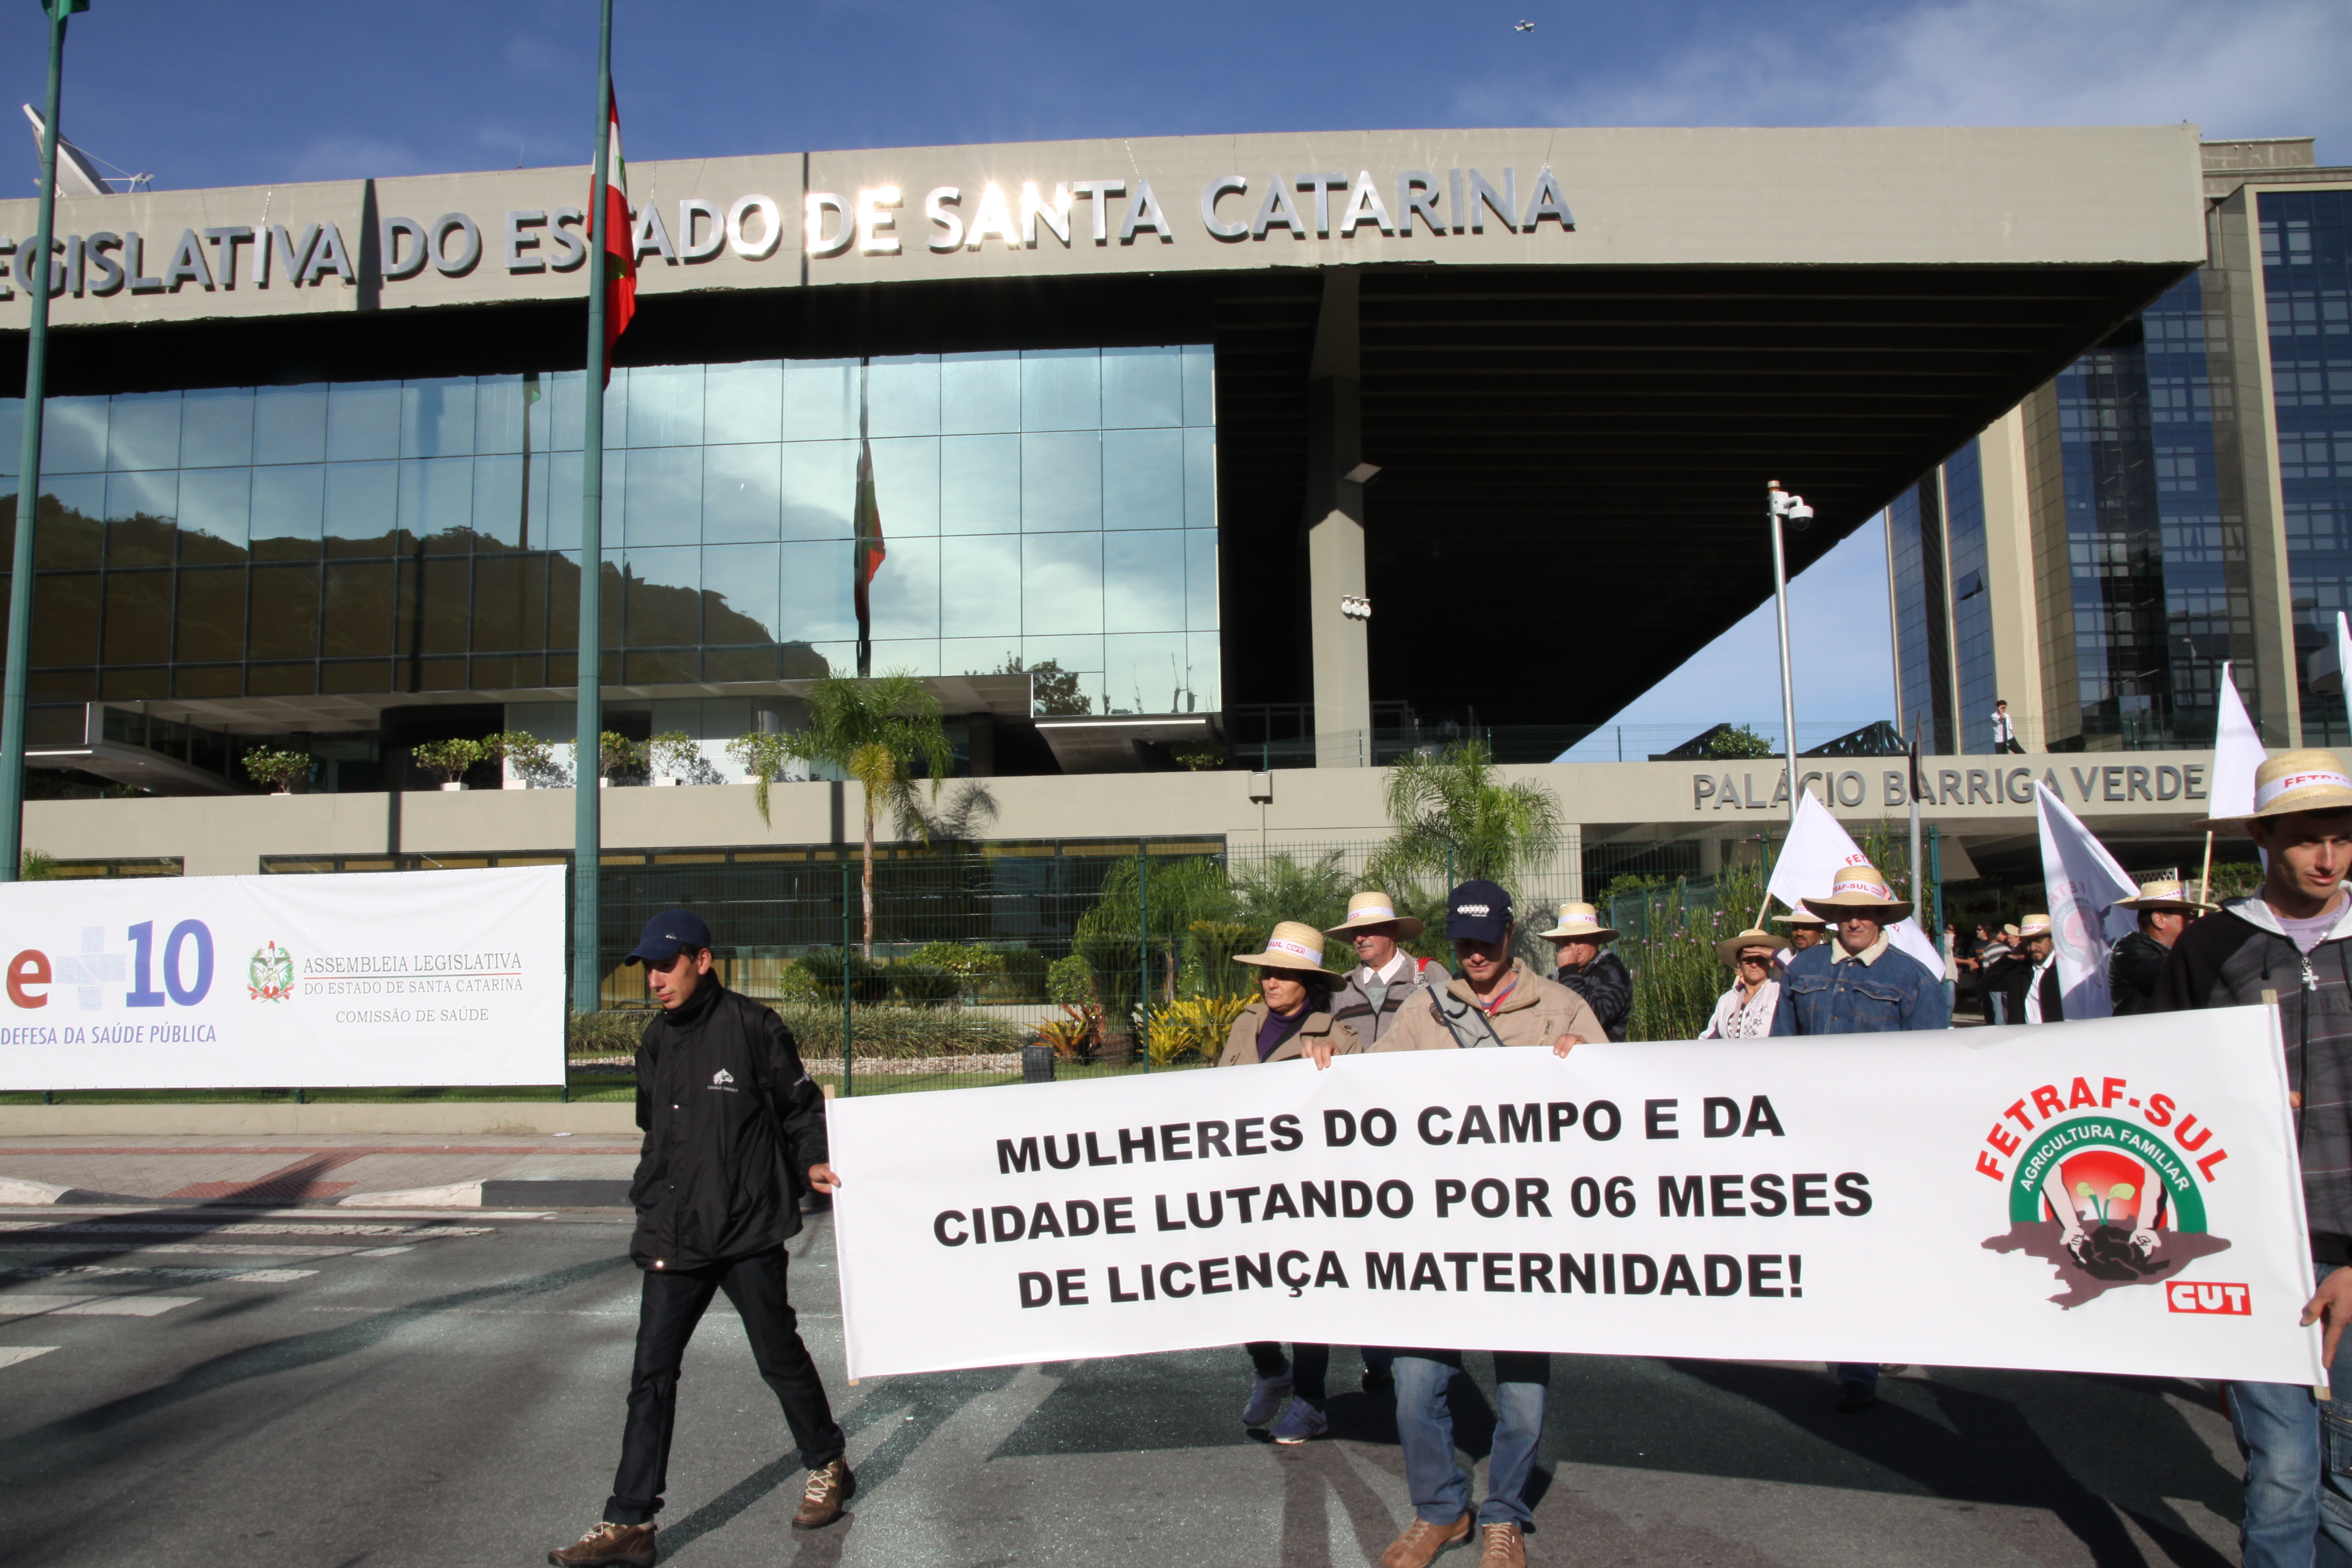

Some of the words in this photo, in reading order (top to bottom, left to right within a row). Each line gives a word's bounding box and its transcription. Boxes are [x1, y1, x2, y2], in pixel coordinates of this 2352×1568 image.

[381, 212, 480, 276] DO
[504, 193, 781, 270] ESADO
[805, 186, 901, 254] DE
[927, 179, 1172, 250] SANTA
[1201, 165, 1575, 242] CATARINA
[2070, 764, 2207, 802] VERDE
[303, 956, 409, 974] ASSEMBLEIA
[414, 952, 523, 972] LEGISLATIVA
[1286, 944, 1305, 954] CUT
[304, 982, 324, 995] DO
[328, 981, 382, 995] ESTADO
[386, 980, 405, 994] DE
[409, 980, 452, 993] SANTA
[456, 978, 523, 992] CATARINA
[0, 1027, 58, 1045] DEFESA
[64, 1026, 86, 1045] DA
[92, 1021, 145, 1044] SAÚDE
[149, 1021, 217, 1043] PÚBLICA
[336, 1008, 411, 1024] COMISSÃO
[416, 1009, 436, 1023] DE
[440, 1006, 490, 1022] SAÚDE
[996, 1114, 1304, 1175] MULHERES
[1323, 1108, 1397, 1147] DO
[1417, 1100, 1622, 1146] CAMPO
[1645, 1099, 1679, 1140] E
[1703, 1095, 1786, 1138] DA
[1975, 1076, 2228, 1183] FETRAF-SUL
[2020, 1125, 2115, 1191] AGRICULTURA
[2120, 1129, 2190, 1191] FAMILIAR
[933, 1197, 1136, 1247] CIDADE
[1155, 1179, 1414, 1232] LUTANDO
[1435, 1177, 1553, 1219] POR
[1570, 1176, 1636, 1218] 06
[1658, 1172, 1872, 1218] MESES
[1018, 1269, 1089, 1309] DE
[1107, 1250, 1350, 1303] LICENÇA
[1365, 1252, 1803, 1298] MATERNIDADE!
[2171, 1284, 2246, 1312] CUT
